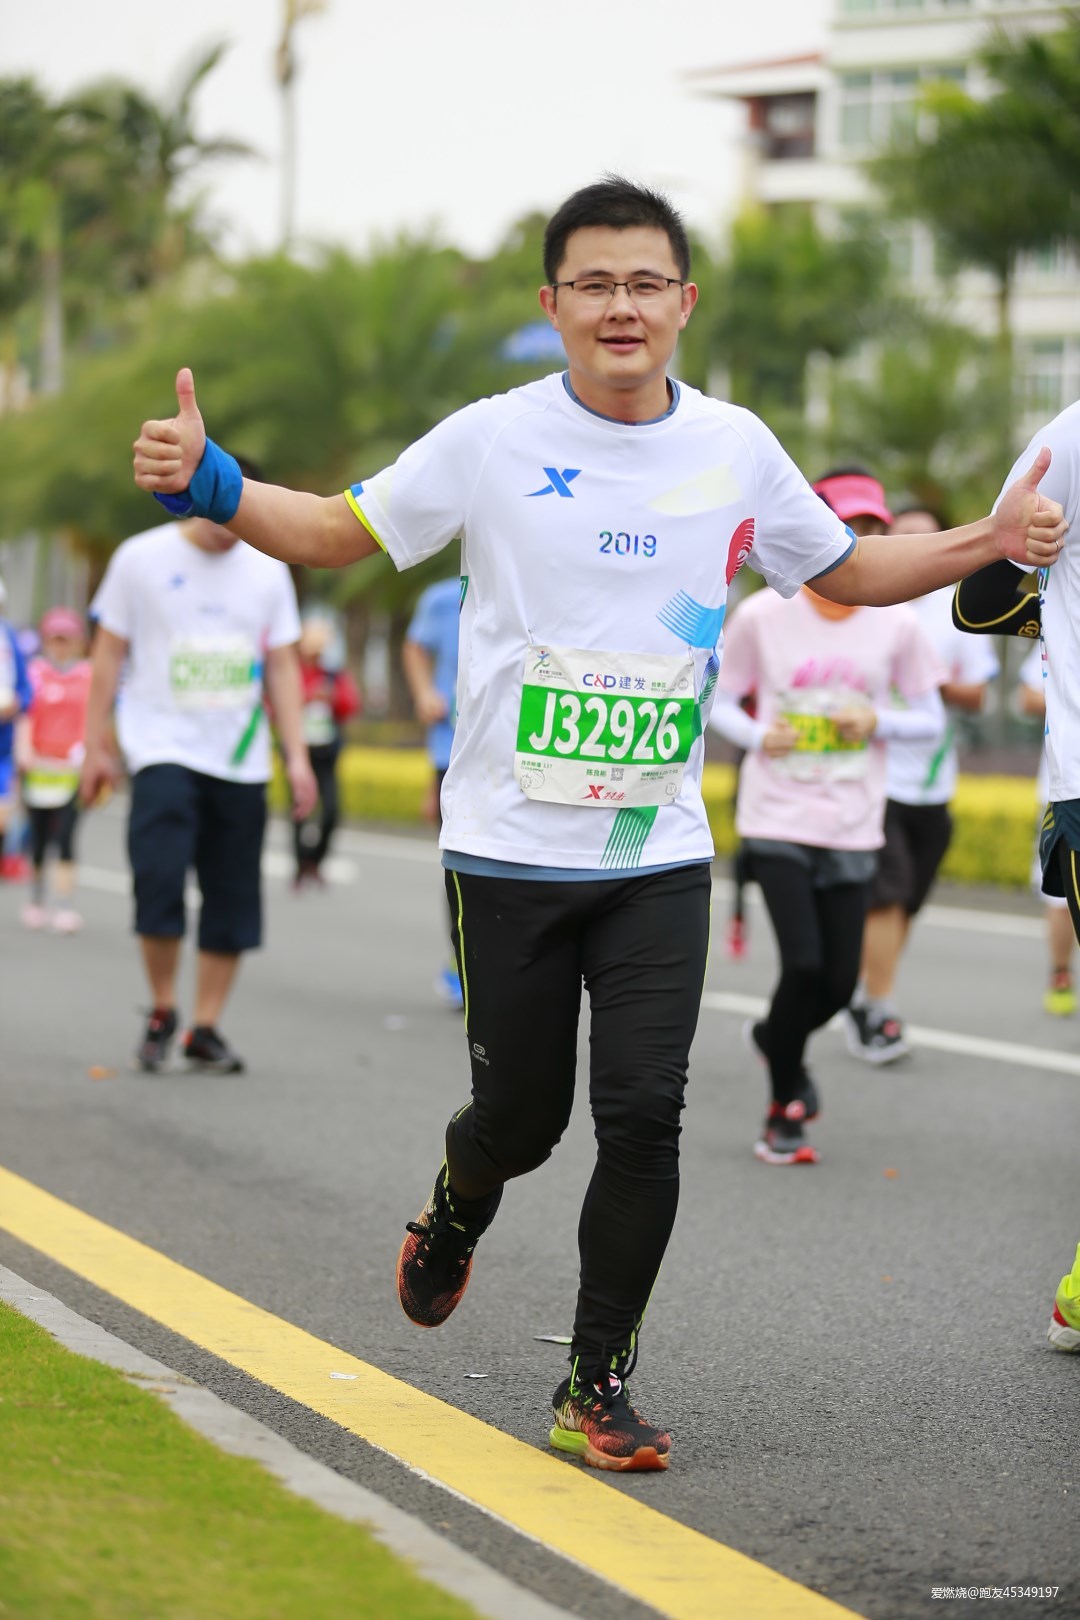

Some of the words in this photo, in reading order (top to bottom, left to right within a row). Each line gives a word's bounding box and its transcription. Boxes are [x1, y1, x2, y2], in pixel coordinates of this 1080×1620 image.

[599, 531, 657, 558] 2019
[583, 673, 617, 689] C&D
[619, 676, 646, 691] 建发
[528, 692, 681, 760] J32926
